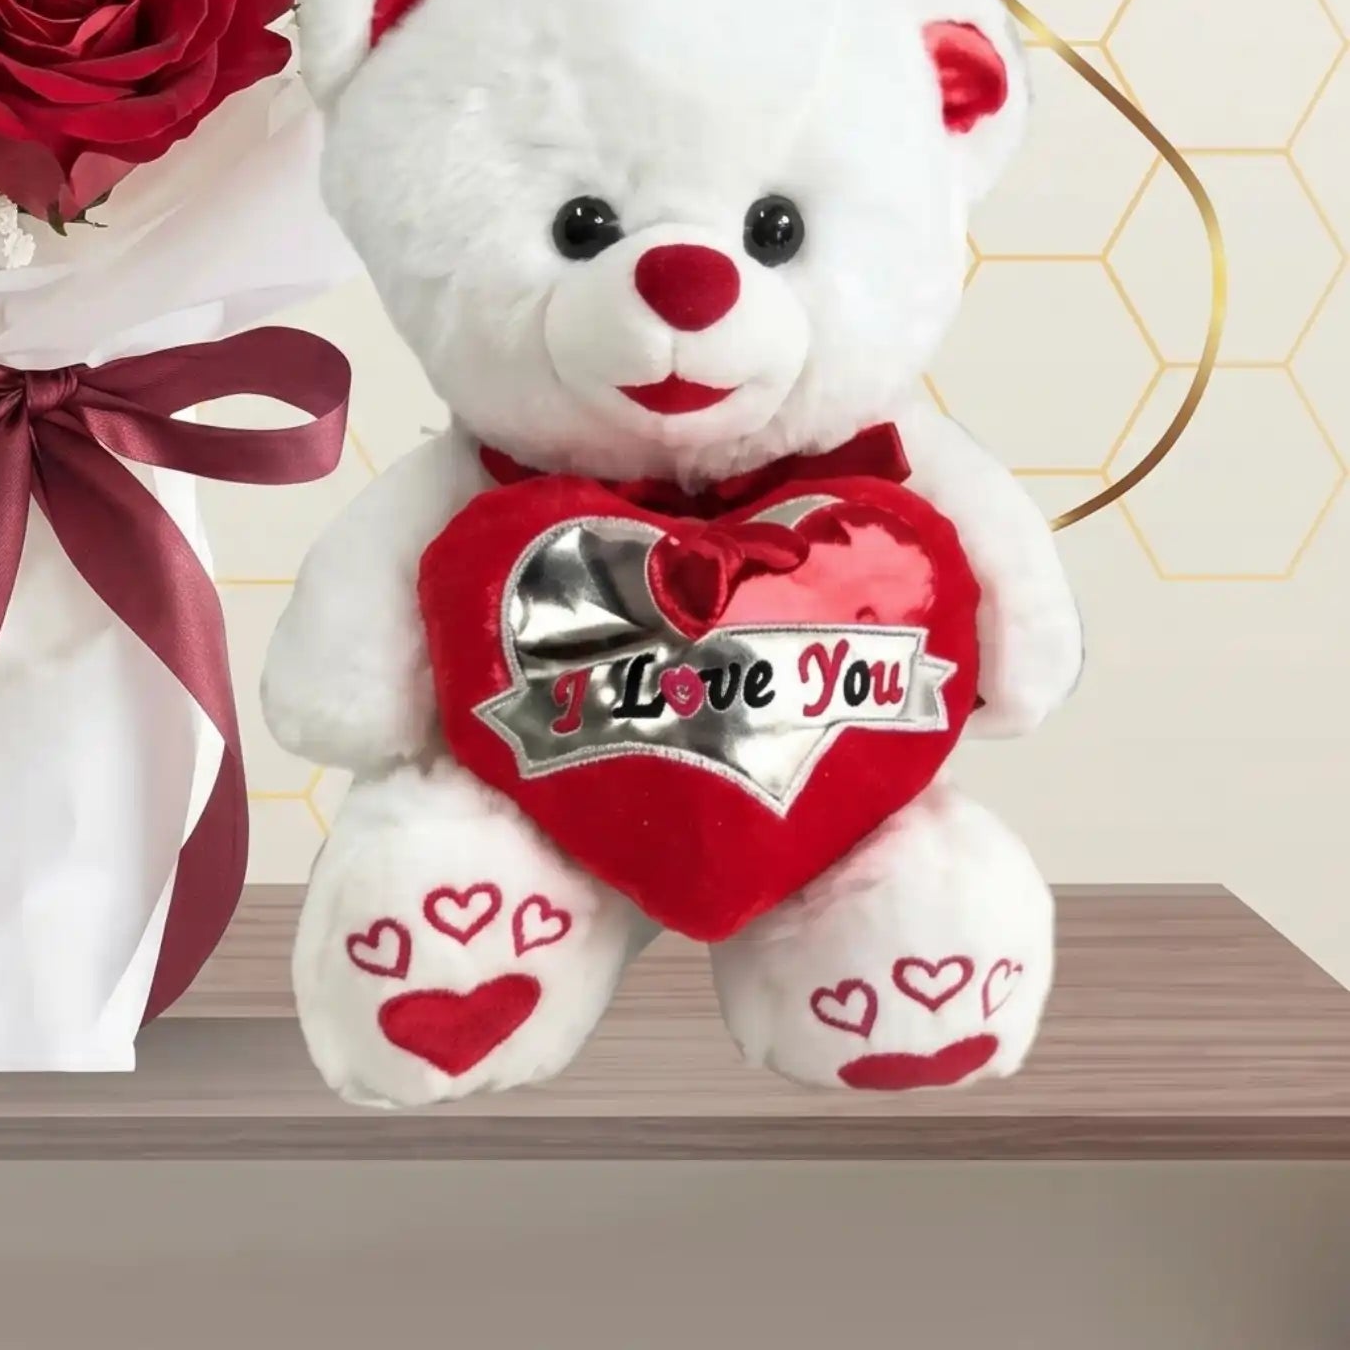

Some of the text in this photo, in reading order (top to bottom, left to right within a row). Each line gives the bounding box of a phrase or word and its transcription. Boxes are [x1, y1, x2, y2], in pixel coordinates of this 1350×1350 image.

[551, 638, 904, 736] I Love You
